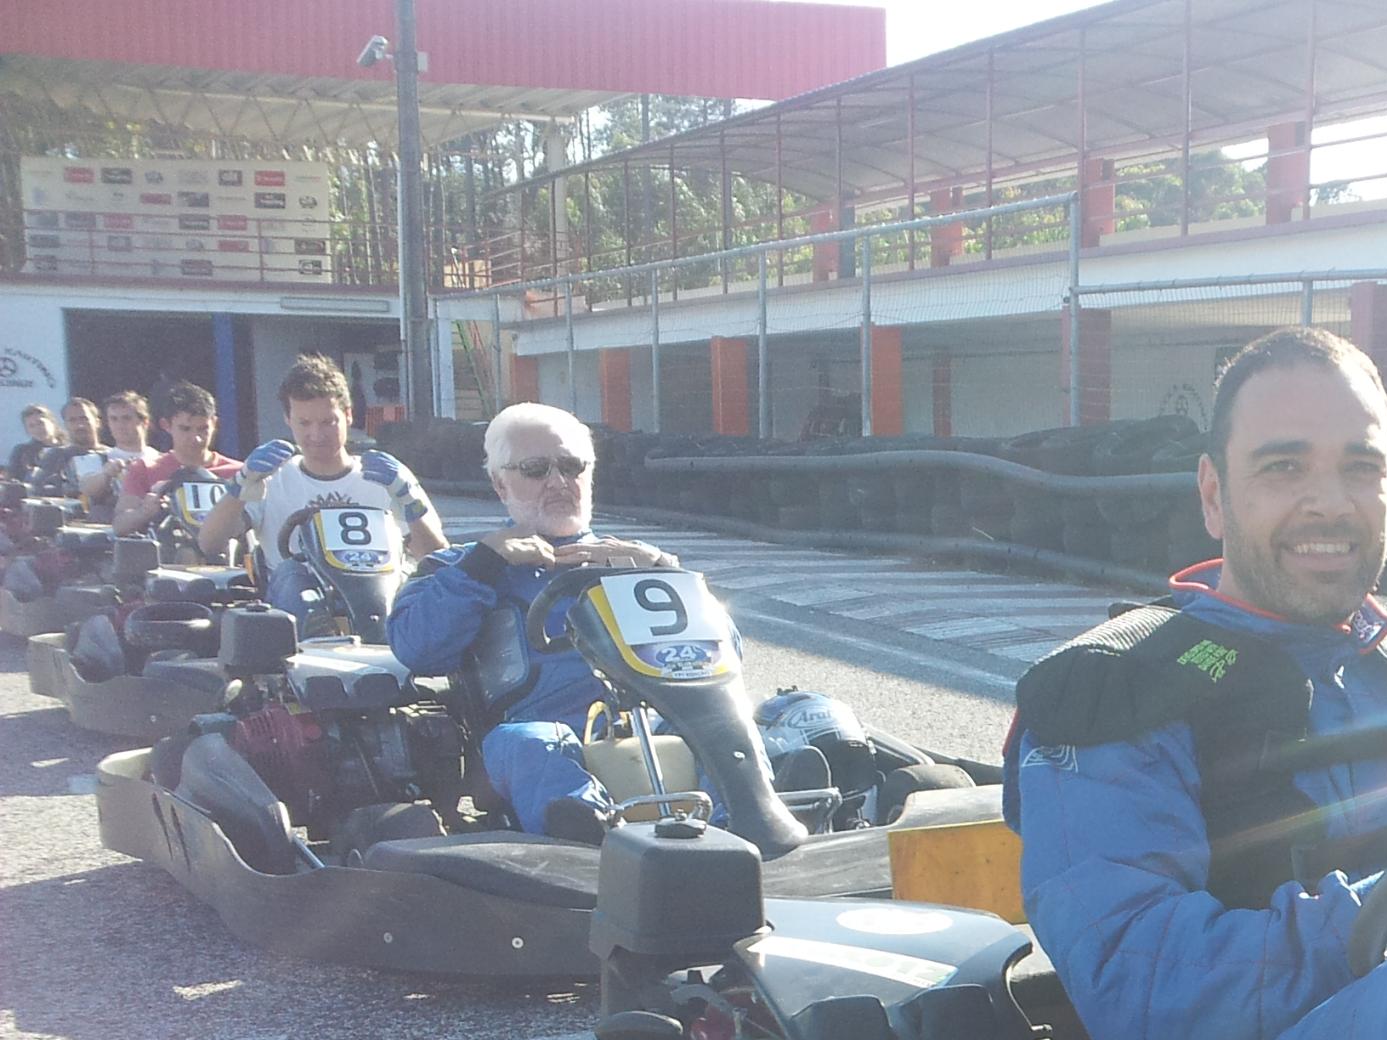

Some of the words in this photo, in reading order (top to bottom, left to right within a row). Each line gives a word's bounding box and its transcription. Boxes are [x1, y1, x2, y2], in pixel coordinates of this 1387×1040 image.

[338, 511, 372, 545] 8
[633, 578, 689, 637] 9
[661, 645, 696, 662] 24
